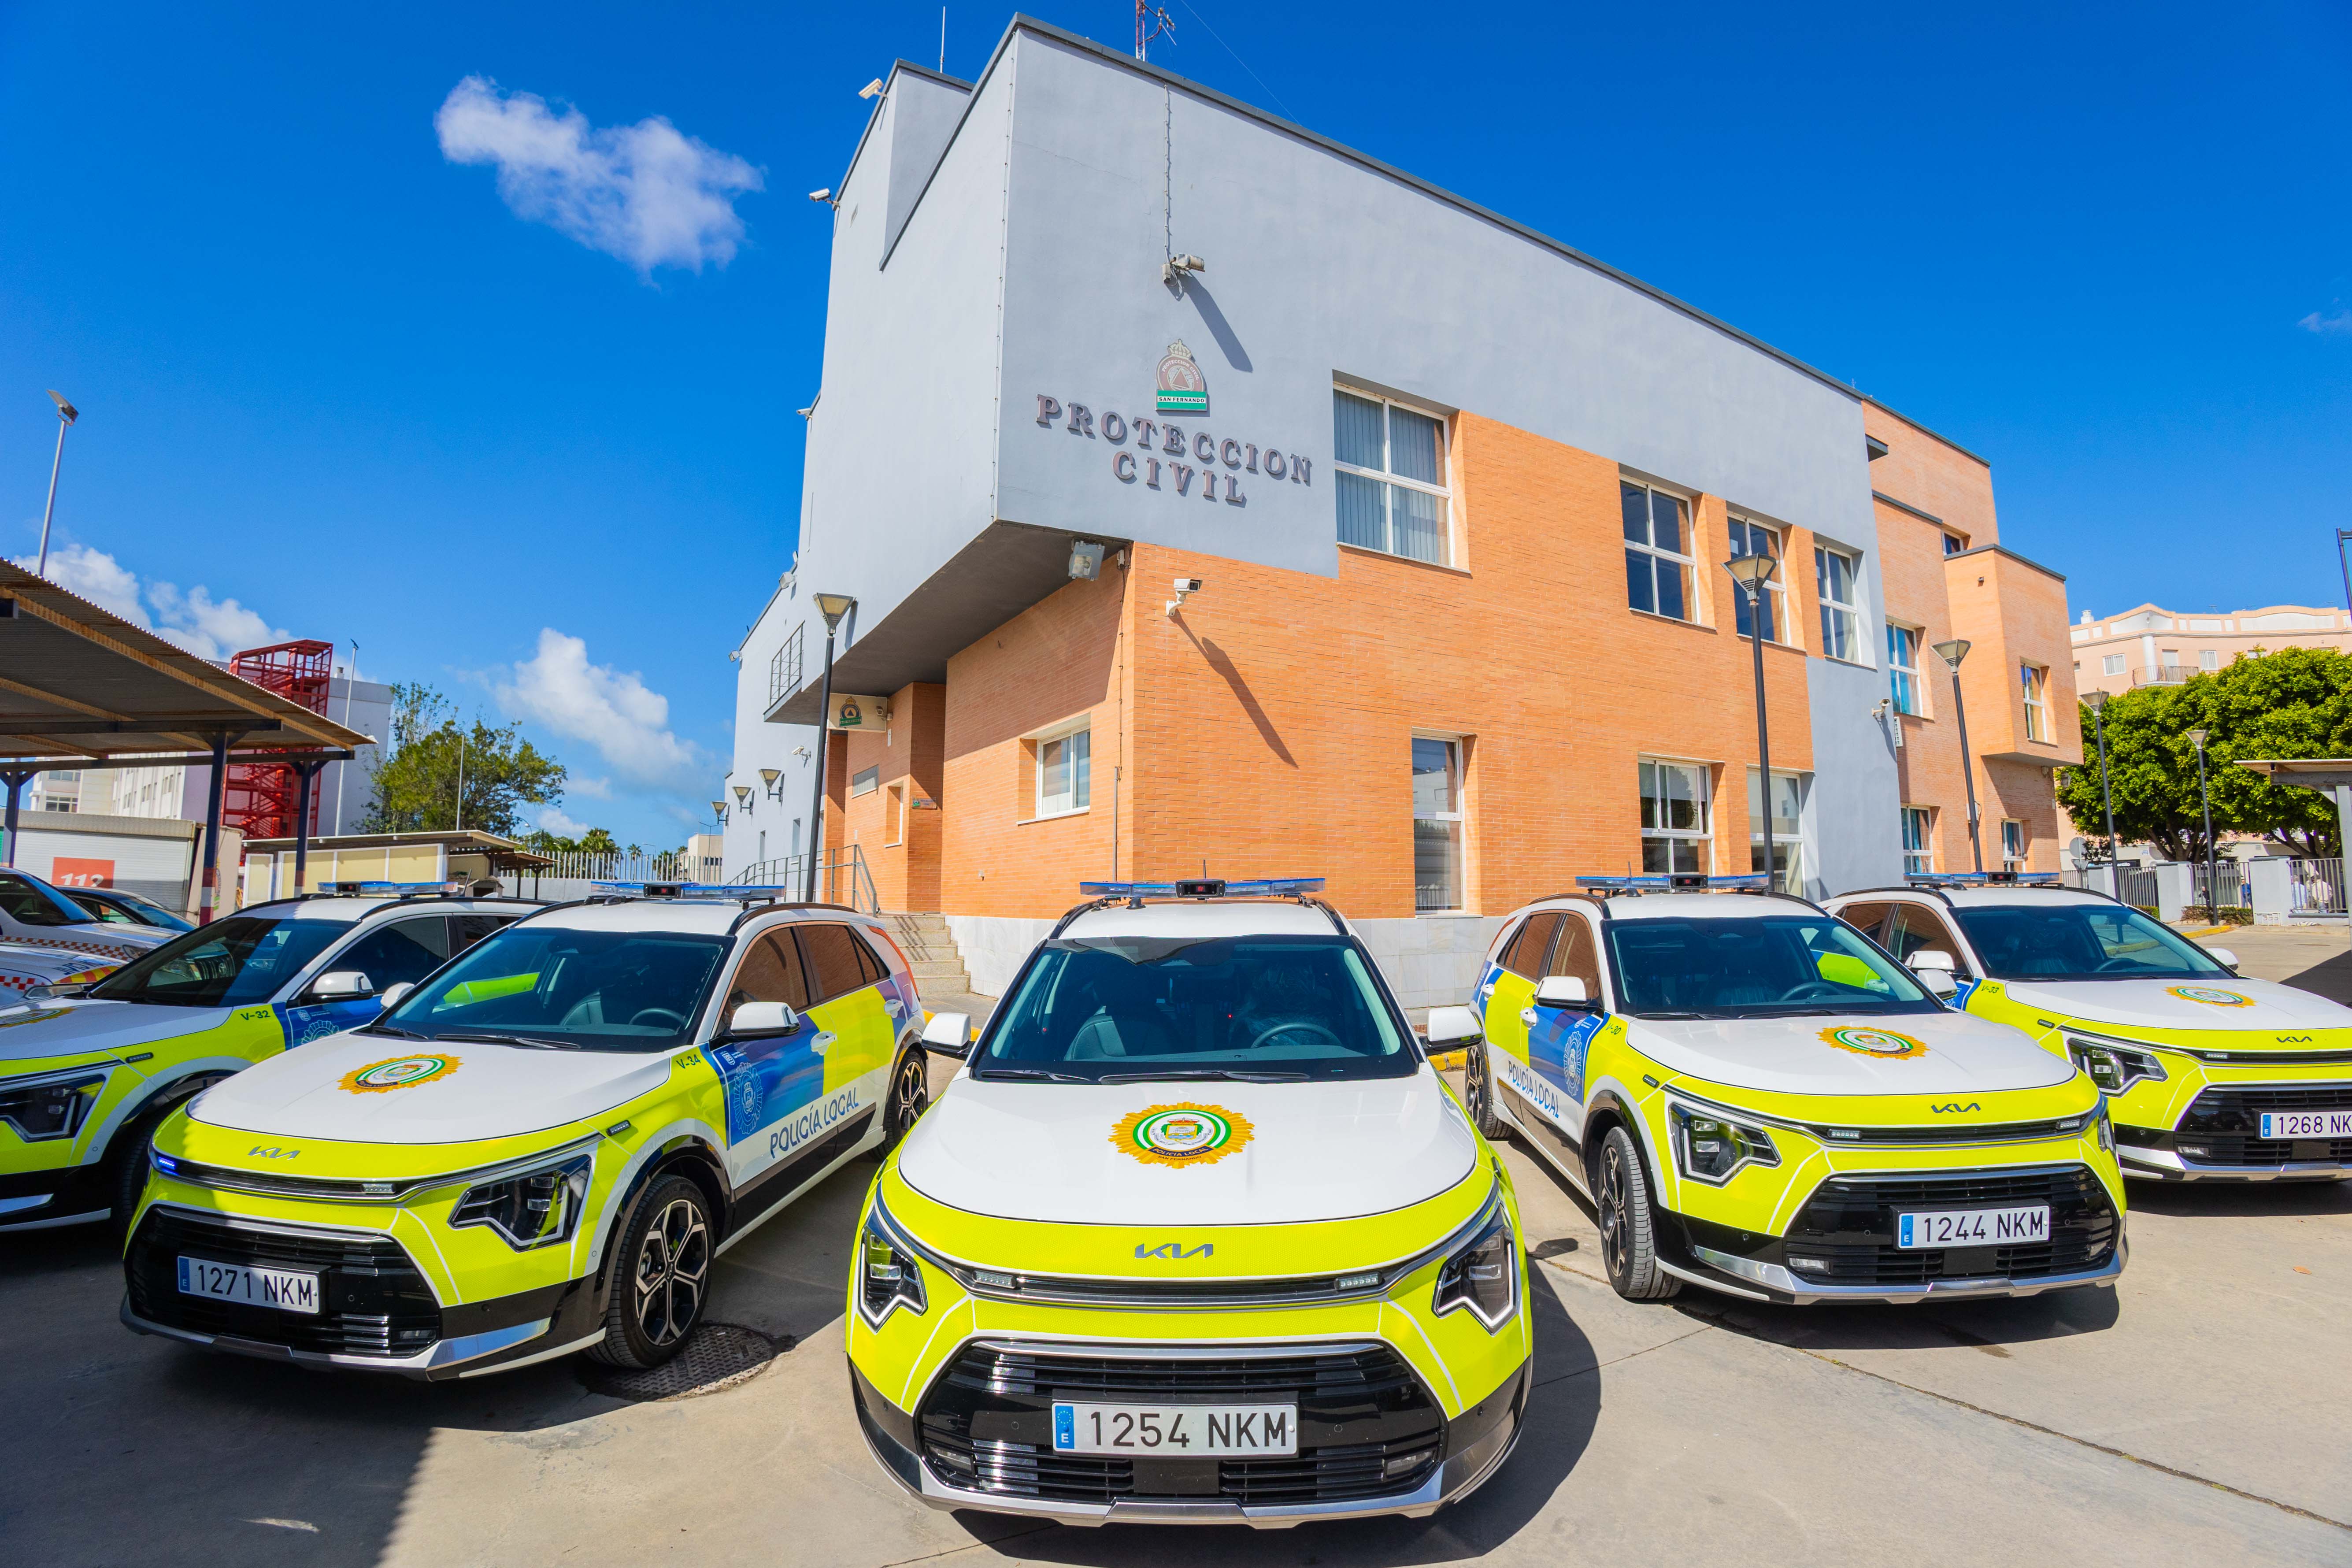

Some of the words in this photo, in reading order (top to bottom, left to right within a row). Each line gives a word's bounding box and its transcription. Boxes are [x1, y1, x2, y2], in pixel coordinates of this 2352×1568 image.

[1162, 360, 1190, 372] PROTECCION
[1190, 367, 1200, 380] CIVIL
[1036, 394, 1312, 482] PROTECCION
[1112, 451, 1245, 503] CIVIL
[60, 873, 104, 887] 112
[1981, 985, 1999, 993] V-33
[241, 1010, 271, 1021] V-32
[1606, 1023, 1621, 1035] V-30
[676, 1054, 700, 1069] V-34
[1508, 1060, 1533, 1097] POLICÍA
[1534, 1080, 1559, 1118] LOCAL
[1931, 1103, 1981, 1113] KIA
[770, 1105, 822, 1159] POLICÍA
[824, 1087, 859, 1126] LOCAL
[2279, 1116, 2323, 1134] 1268
[248, 1145, 301, 1160] KIA
[1924, 1215, 1986, 1242] 1244
[1996, 1211, 2044, 1238] NKM
[1135, 1243, 1213, 1259] KIA
[198, 1265, 251, 1298] 1271
[264, 1275, 312, 1306] NKM
[1061, 1433, 1069, 1443] E
[1091, 1411, 1189, 1448] 1254
[1208, 1412, 1287, 1448] NKM
